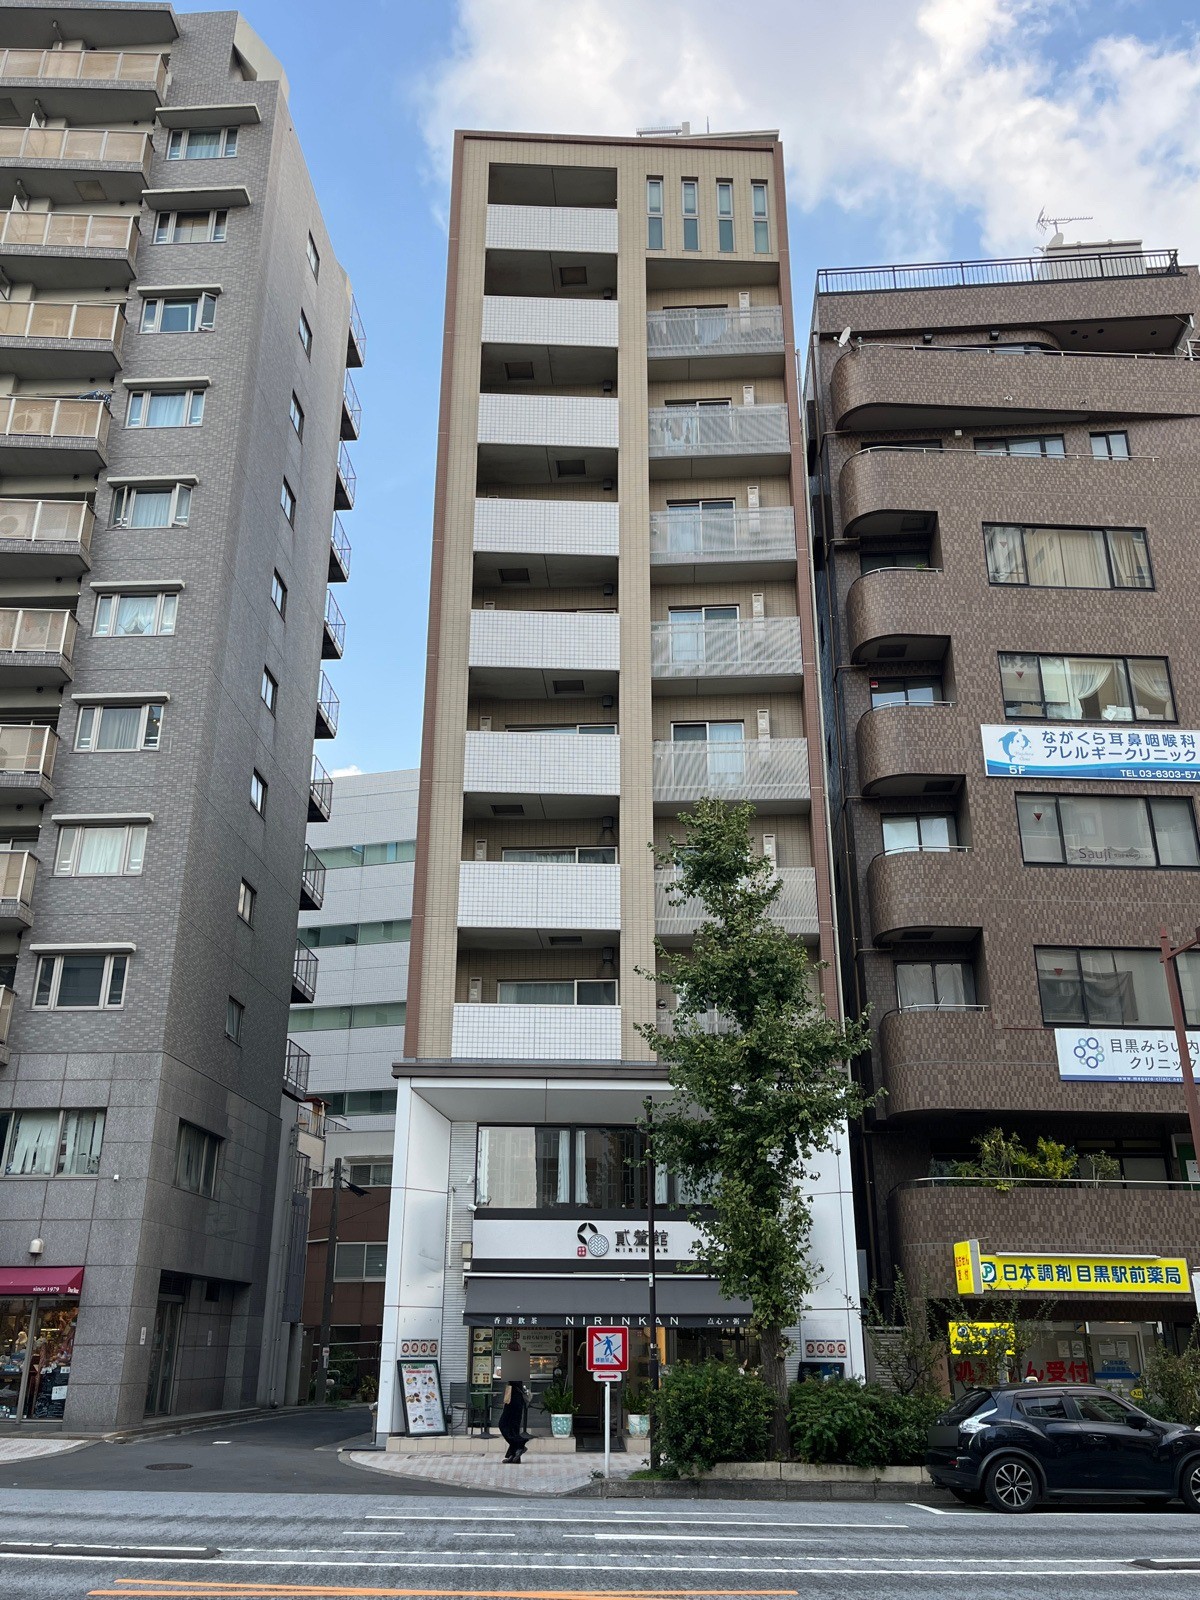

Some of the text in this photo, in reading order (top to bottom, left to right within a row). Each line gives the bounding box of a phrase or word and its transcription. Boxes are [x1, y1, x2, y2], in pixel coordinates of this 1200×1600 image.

[1041, 730, 1196, 748] ながくら耳鼻咽喉科
[1043, 745, 1197, 762] アレルギークリニック
[1009, 765, 1026, 775] 5F
[1120, 769, 1138, 778] TEL
[1078, 847, 1112, 862] Sauji
[1002, 1264, 1072, 1282] 日本調剤
[1076, 1264, 1182, 1284] 目黒駅前薬局
